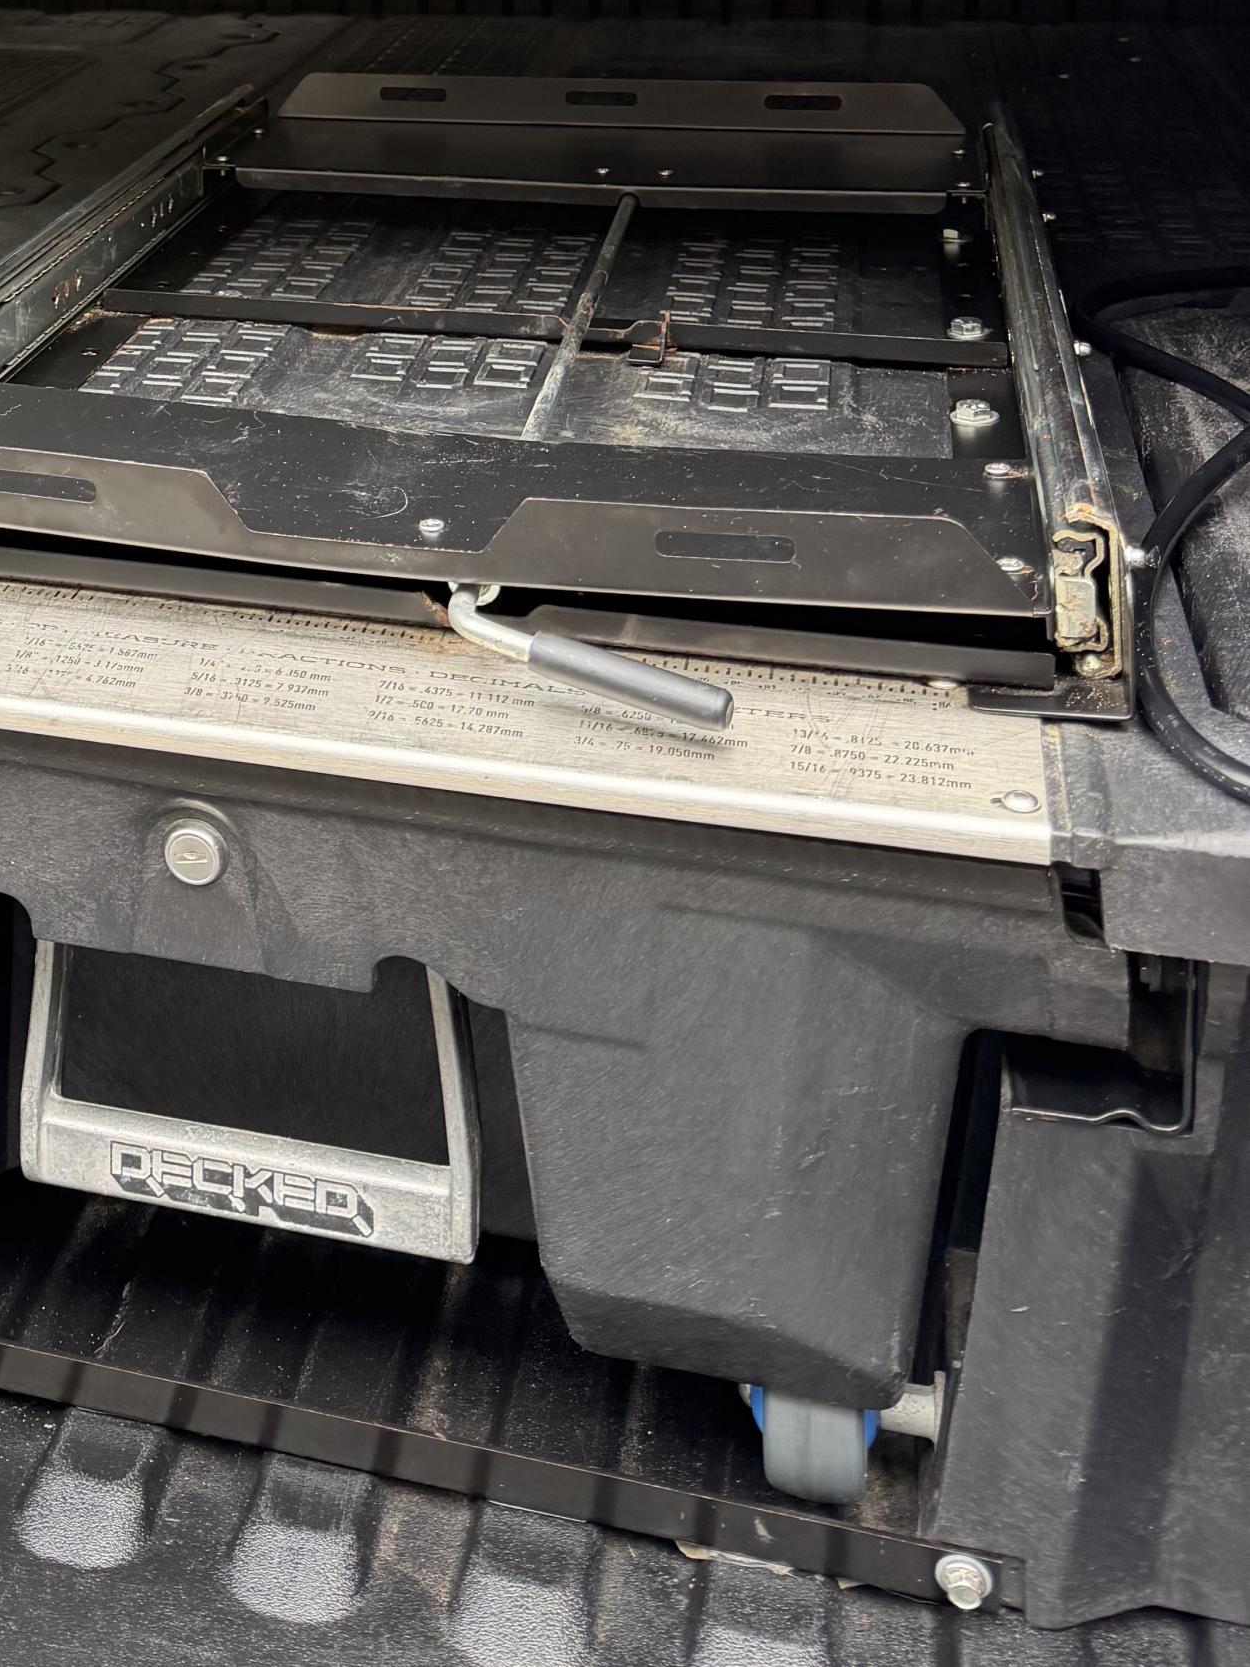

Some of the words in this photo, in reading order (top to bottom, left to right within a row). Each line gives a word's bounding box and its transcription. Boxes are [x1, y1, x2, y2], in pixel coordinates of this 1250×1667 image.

[430, 670, 586, 696] DECIMALS
[375, 694, 394, 705] 1/2
[486, 710, 509, 720] mm
[512, 698, 535, 708] mm
[790, 744, 812, 756] 7/8
[110, 1140, 374, 1237] DECKED
